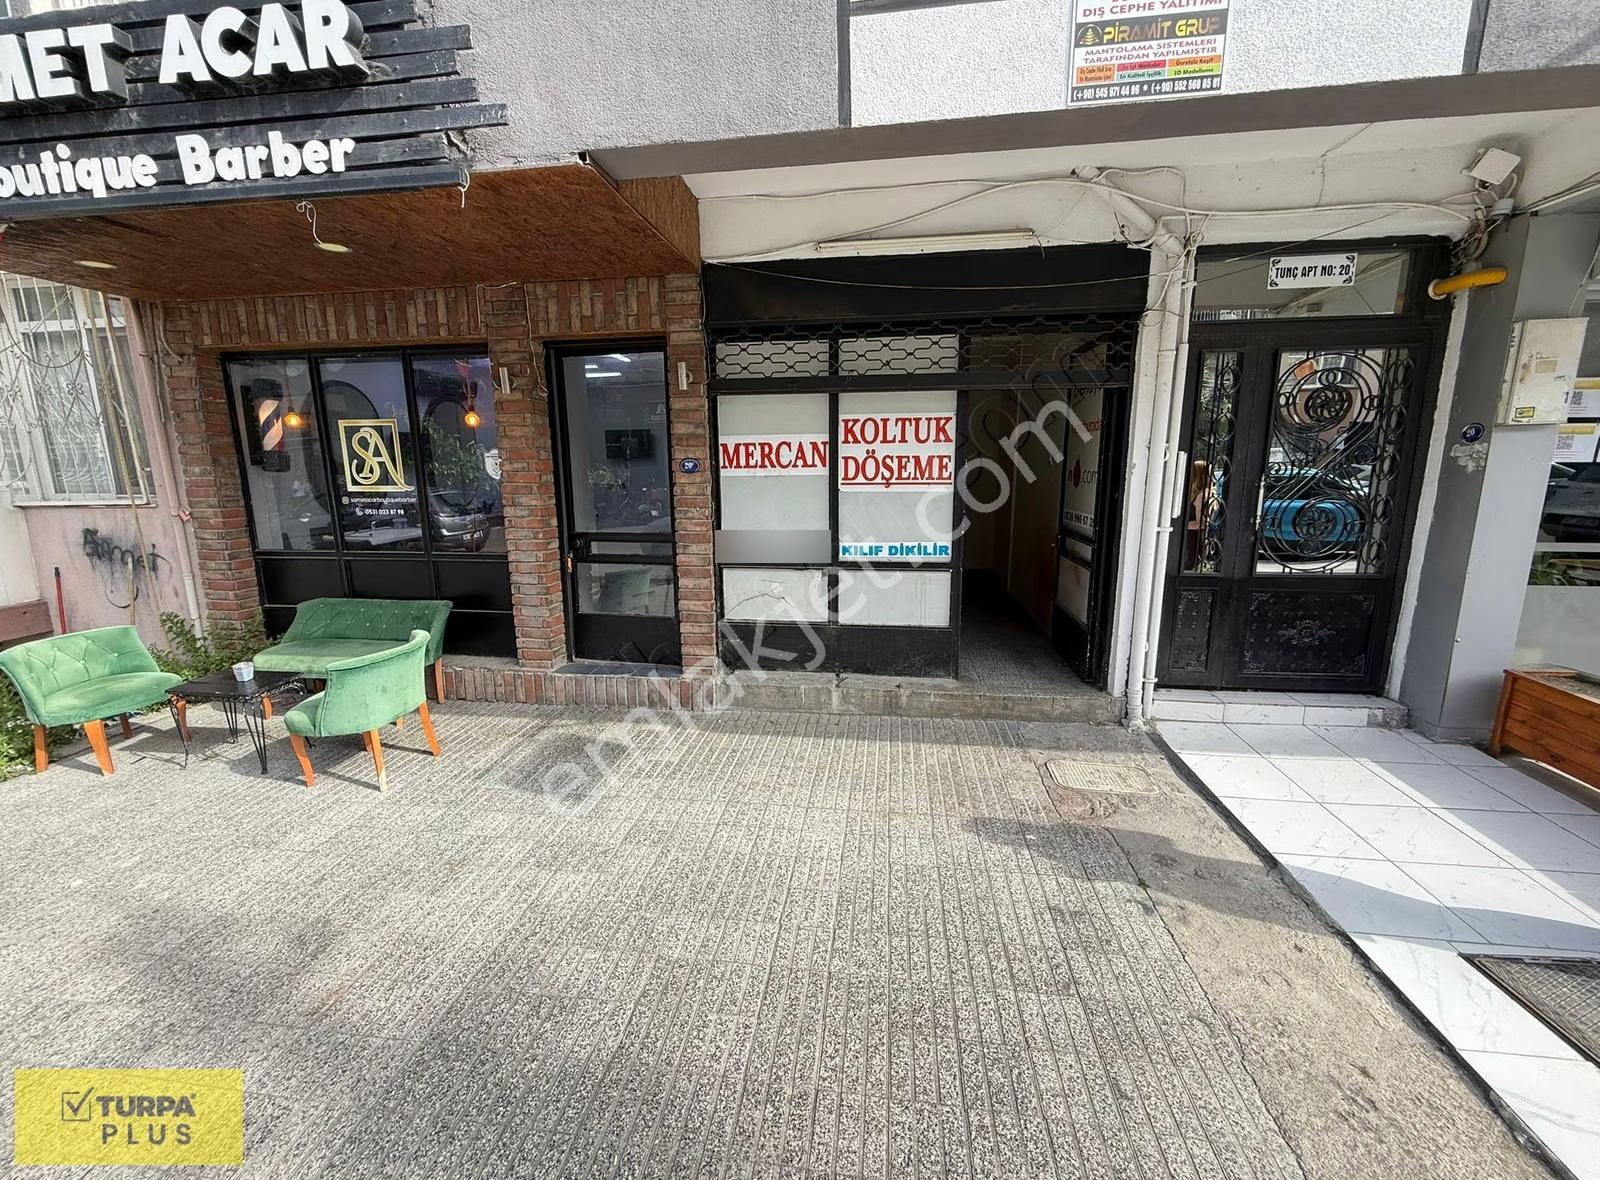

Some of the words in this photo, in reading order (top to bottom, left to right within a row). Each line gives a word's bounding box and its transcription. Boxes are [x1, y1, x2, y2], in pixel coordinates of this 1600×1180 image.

[1082, 7, 1105, 19] DIŞ
[1109, 2, 1155, 15] CEPHE
[1103, 18, 1172, 44] PİRAMİT
[0, 23, 116, 100] MET
[158, 1, 357, 85] ACAR
[1083, 52, 1150, 65] TARAFINDAN
[1084, 44, 1153, 57] MANTOLAMA
[0, 143, 158, 198] outique
[175, 131, 356, 186] Barber
[1274, 266, 1299, 281] TUNÇ
[1301, 265, 1318, 278] APT
[1321, 264, 1337, 277] NO:
[1338, 264, 1351, 276] 20
[841, 416, 953, 445] KOLTUK
[720, 440, 830, 470] MERCAN
[841, 449, 953, 488] DÖŞEME
[841, 545, 883, 556] KILIF
[888, 543, 950, 556] DİKİLİR
